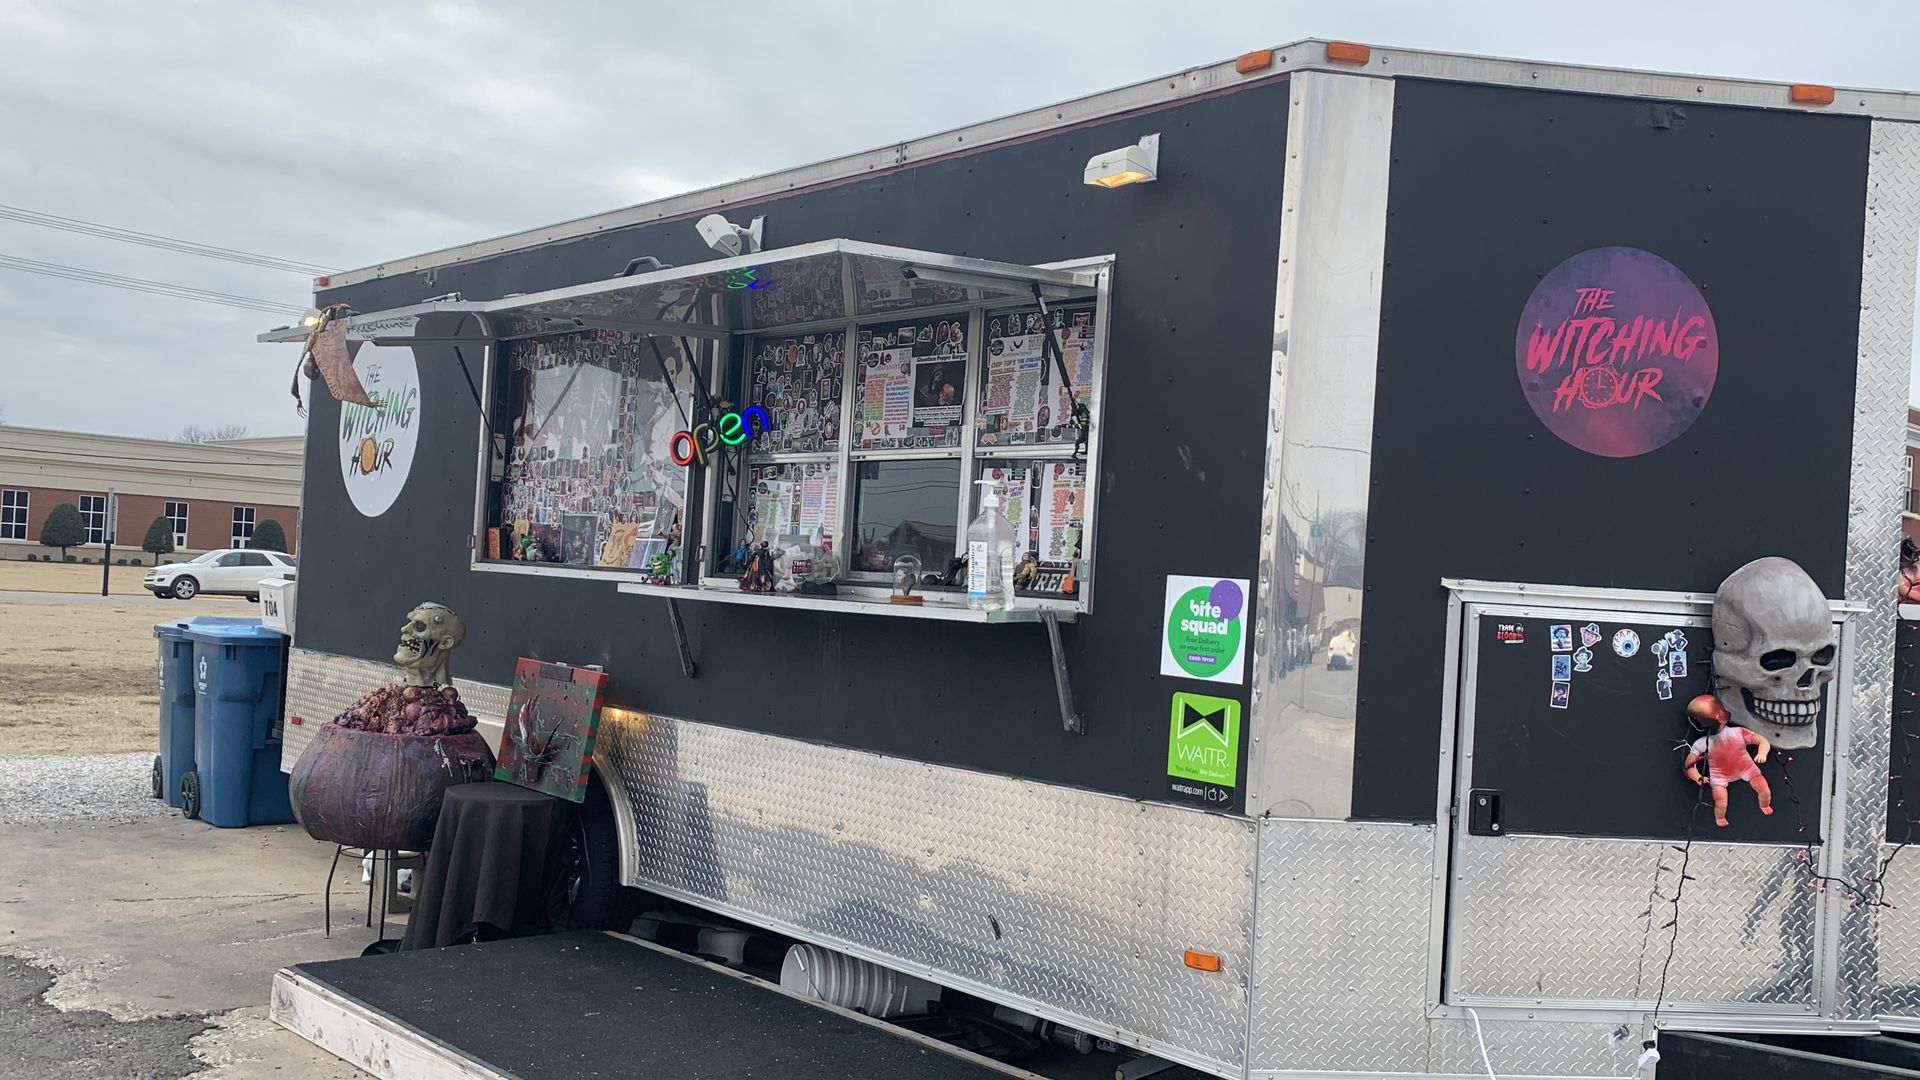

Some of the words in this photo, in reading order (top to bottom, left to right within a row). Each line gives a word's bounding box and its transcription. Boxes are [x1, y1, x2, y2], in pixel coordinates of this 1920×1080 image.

[1573, 288, 1616, 316] THE
[1526, 304, 1706, 374] WITCHING
[365, 364, 382, 386] THE
[1552, 362, 1663, 412] HOUR
[342, 385, 417, 443] WITCHING
[670, 406, 769, 467] open
[349, 437, 395, 480] HOUR
[1189, 599, 1221, 618] bite
[1180, 618, 1229, 637] squad
[1198, 638, 1220, 646] Delivery
[1172, 784, 1204, 796] waitrapp.com
